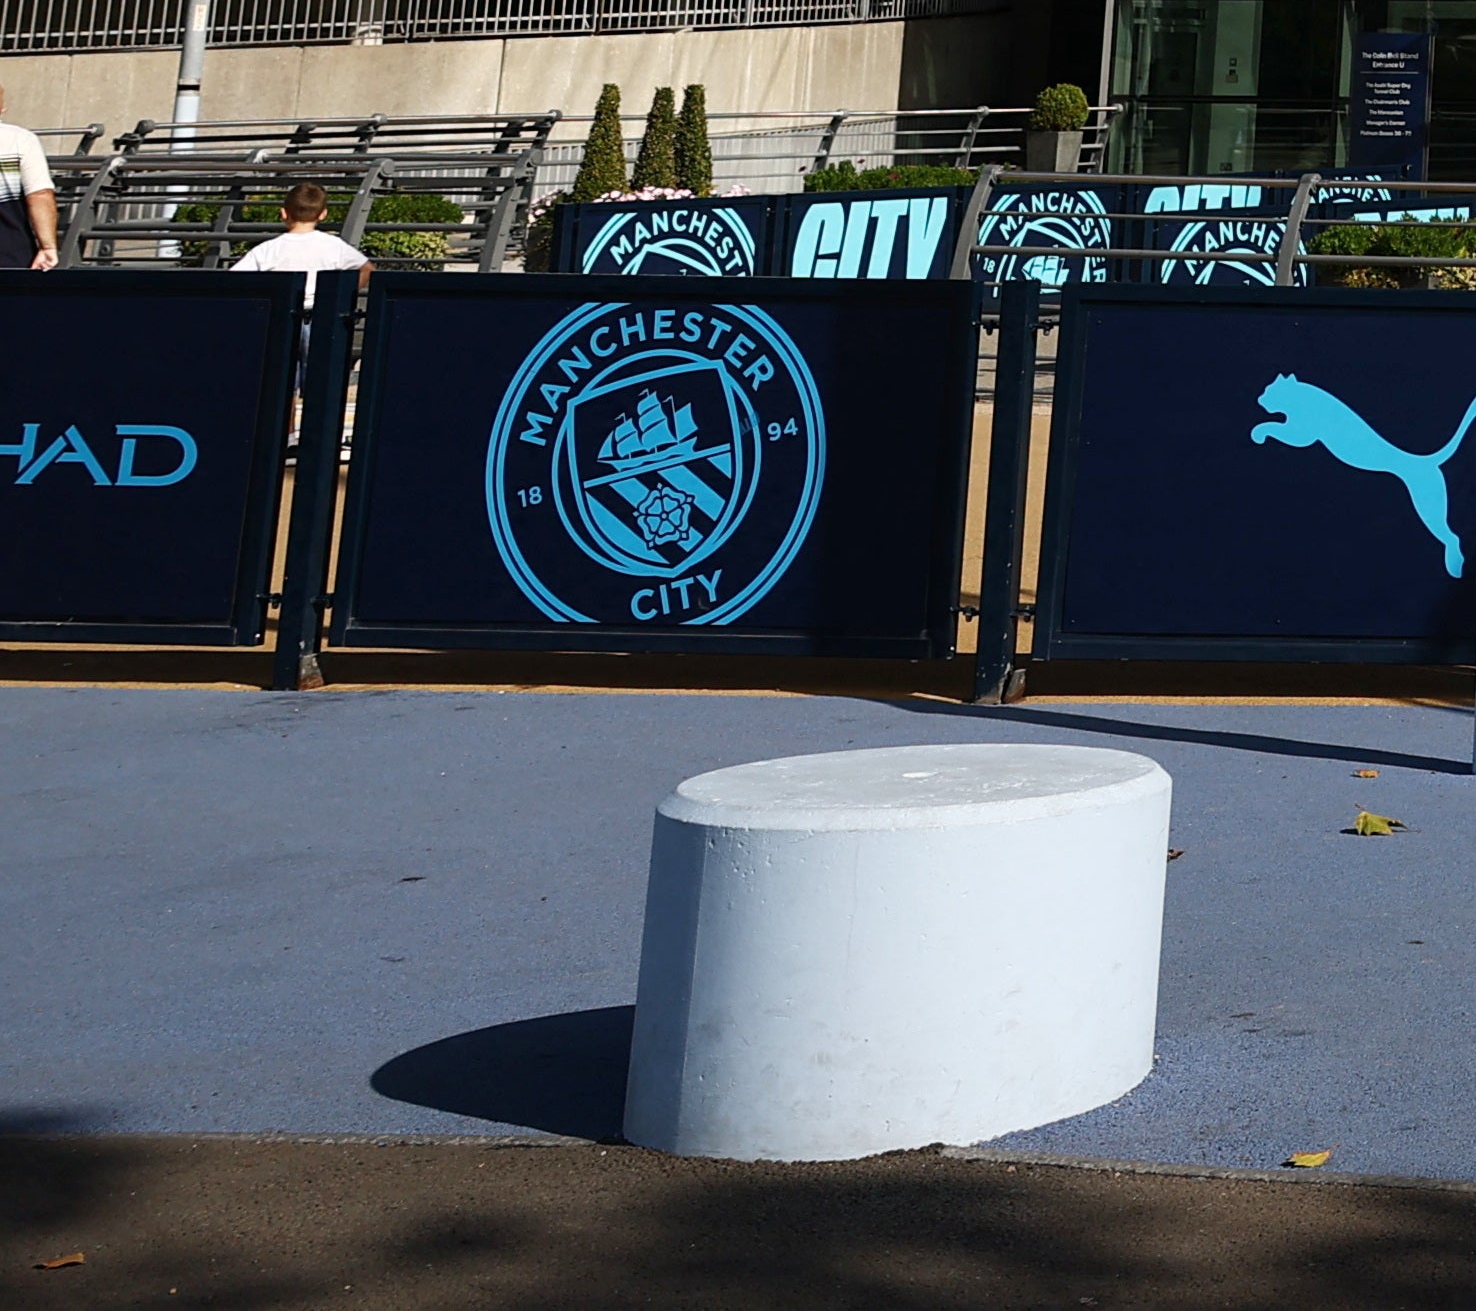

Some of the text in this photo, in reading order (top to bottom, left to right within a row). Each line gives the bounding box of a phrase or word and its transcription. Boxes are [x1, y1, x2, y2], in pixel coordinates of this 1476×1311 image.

[792, 197, 947, 279] CITY
[519, 309, 775, 449] MANCHESTER
[518, 419, 799, 508] 18 94
[629, 568, 723, 623] CITY
